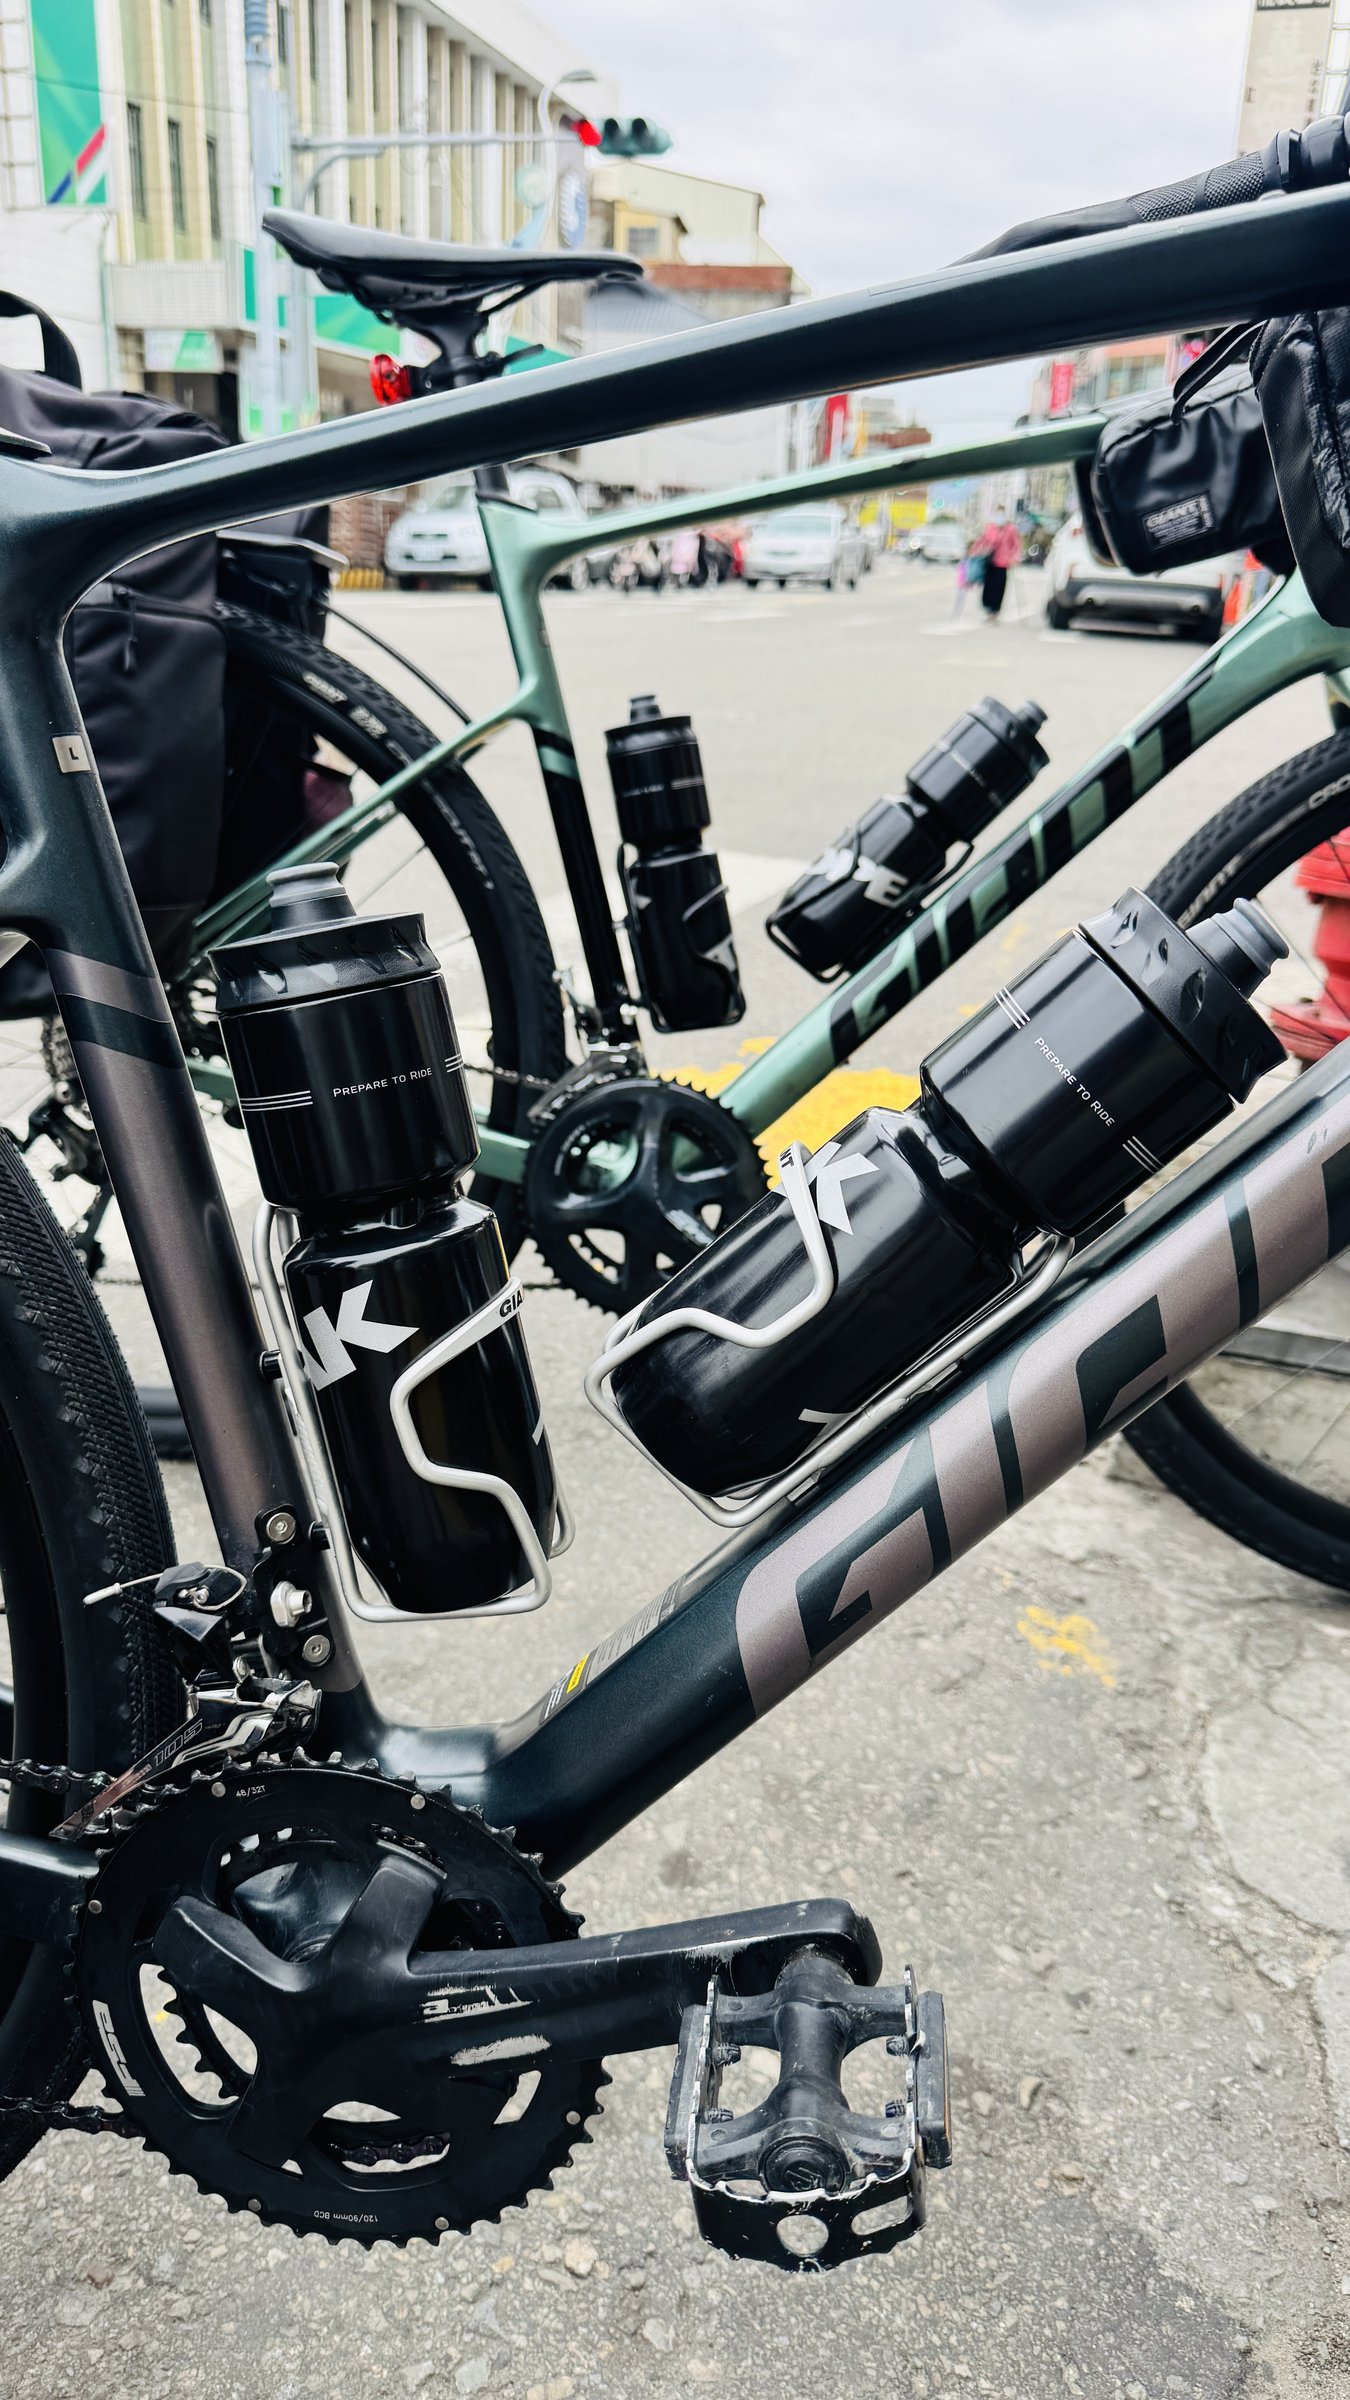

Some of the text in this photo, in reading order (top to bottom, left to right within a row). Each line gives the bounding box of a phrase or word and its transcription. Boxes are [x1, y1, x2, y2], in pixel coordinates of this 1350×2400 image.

[68, 746, 79, 760] L
[332, 1067, 433, 1098] PREPARE TO RIDE
[1034, 1036, 1116, 1127] PREPARE TO RIDE
[154, 1718, 204, 1768] 105
[235, 1784, 267, 1798] 48/32T
[313, 2210, 379, 2223] 120/90mm BCD
